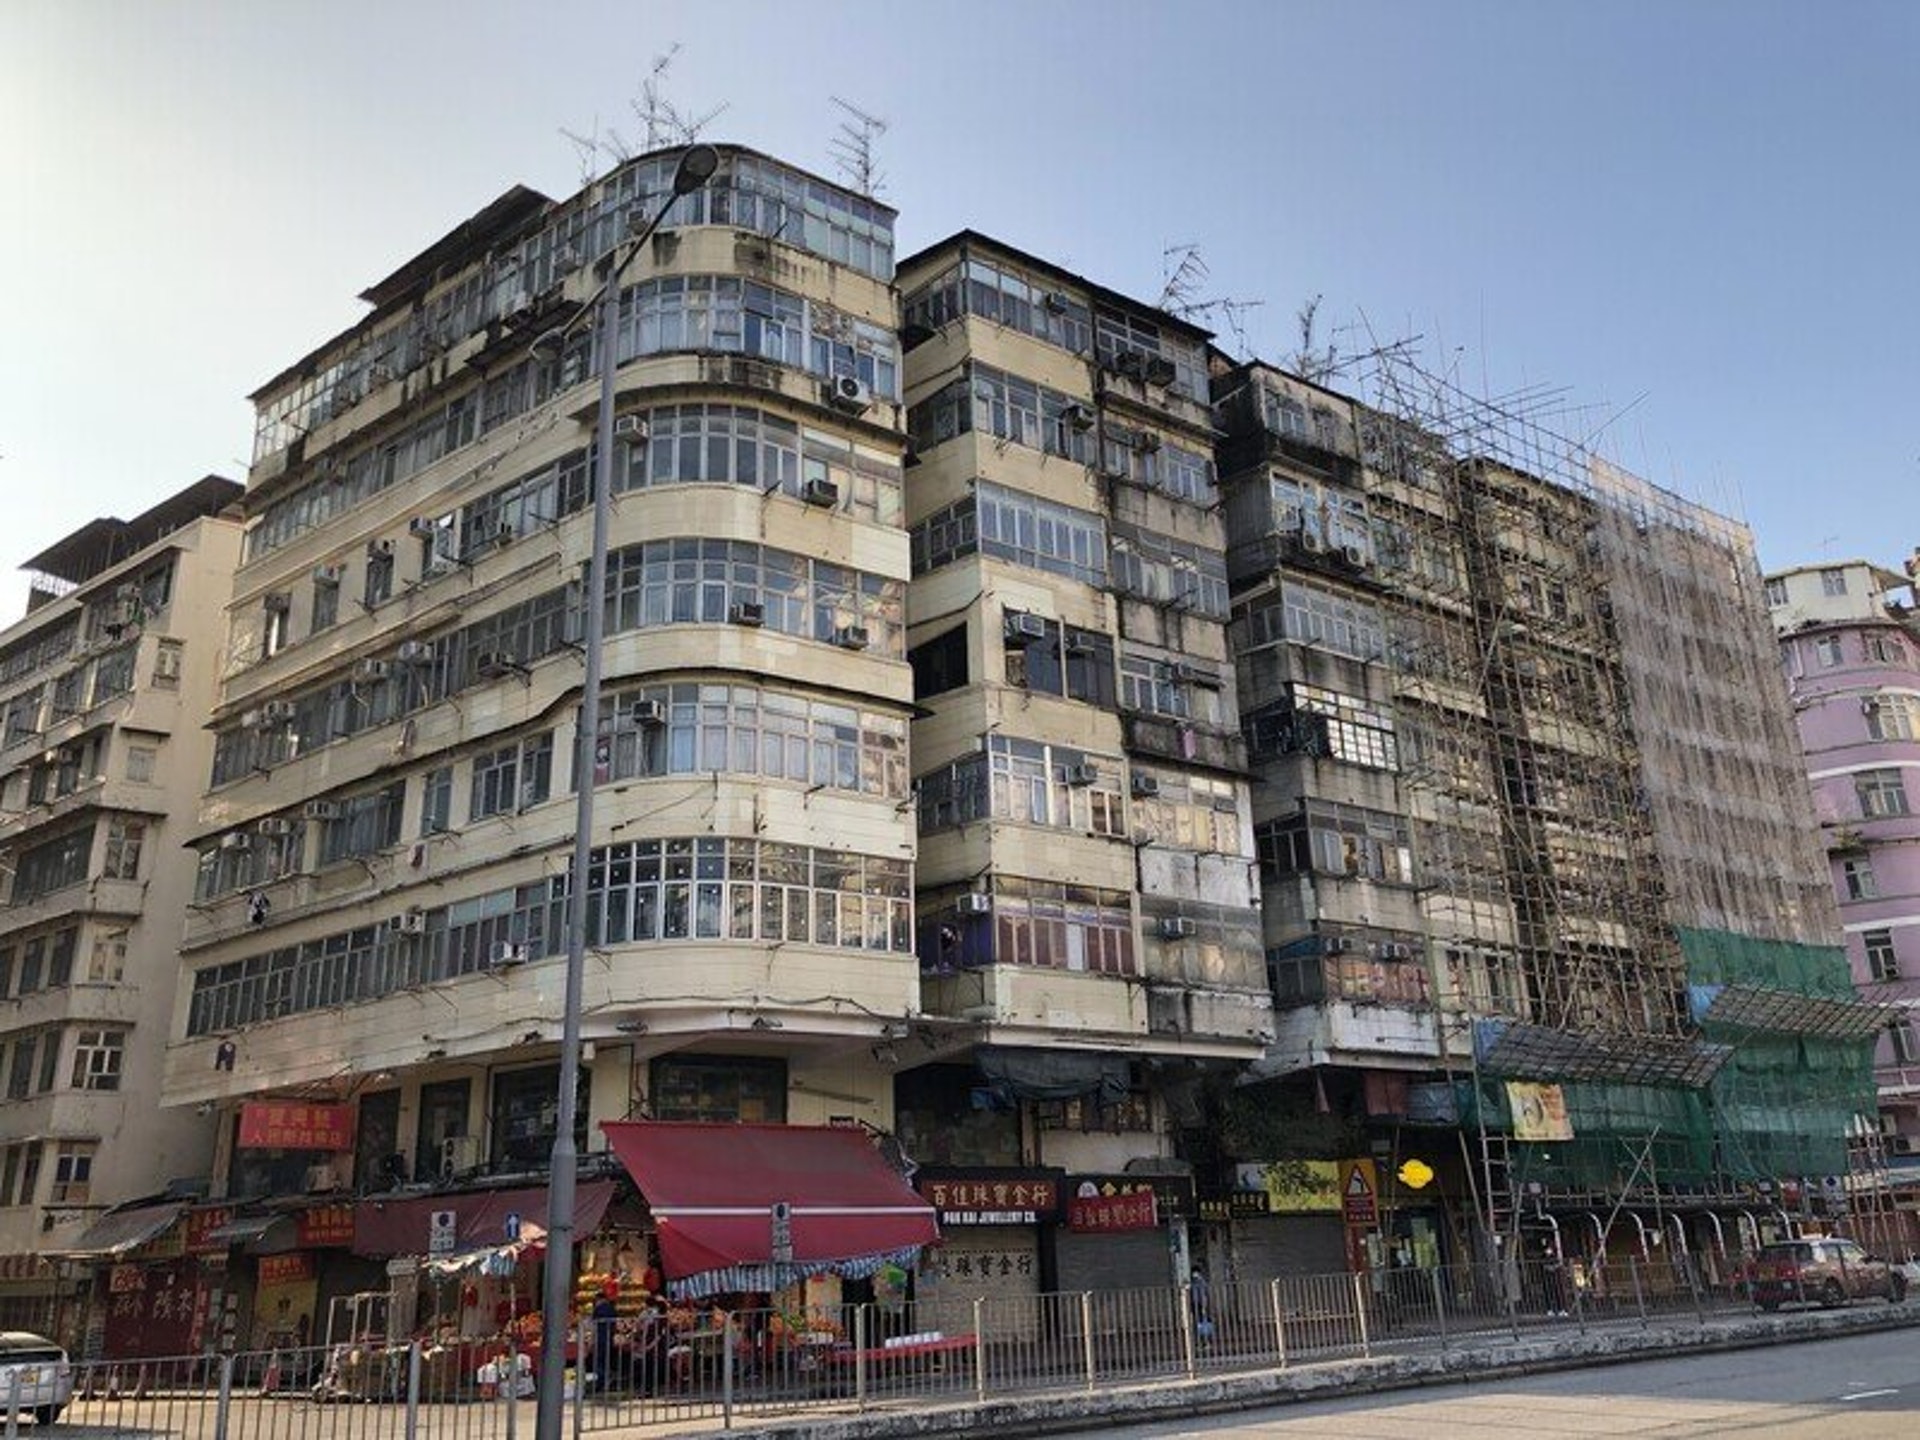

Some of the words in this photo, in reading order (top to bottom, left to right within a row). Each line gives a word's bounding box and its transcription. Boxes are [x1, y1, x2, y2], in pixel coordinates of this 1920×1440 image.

[932, 1184, 1049, 1206] 百佳珠寶金行
